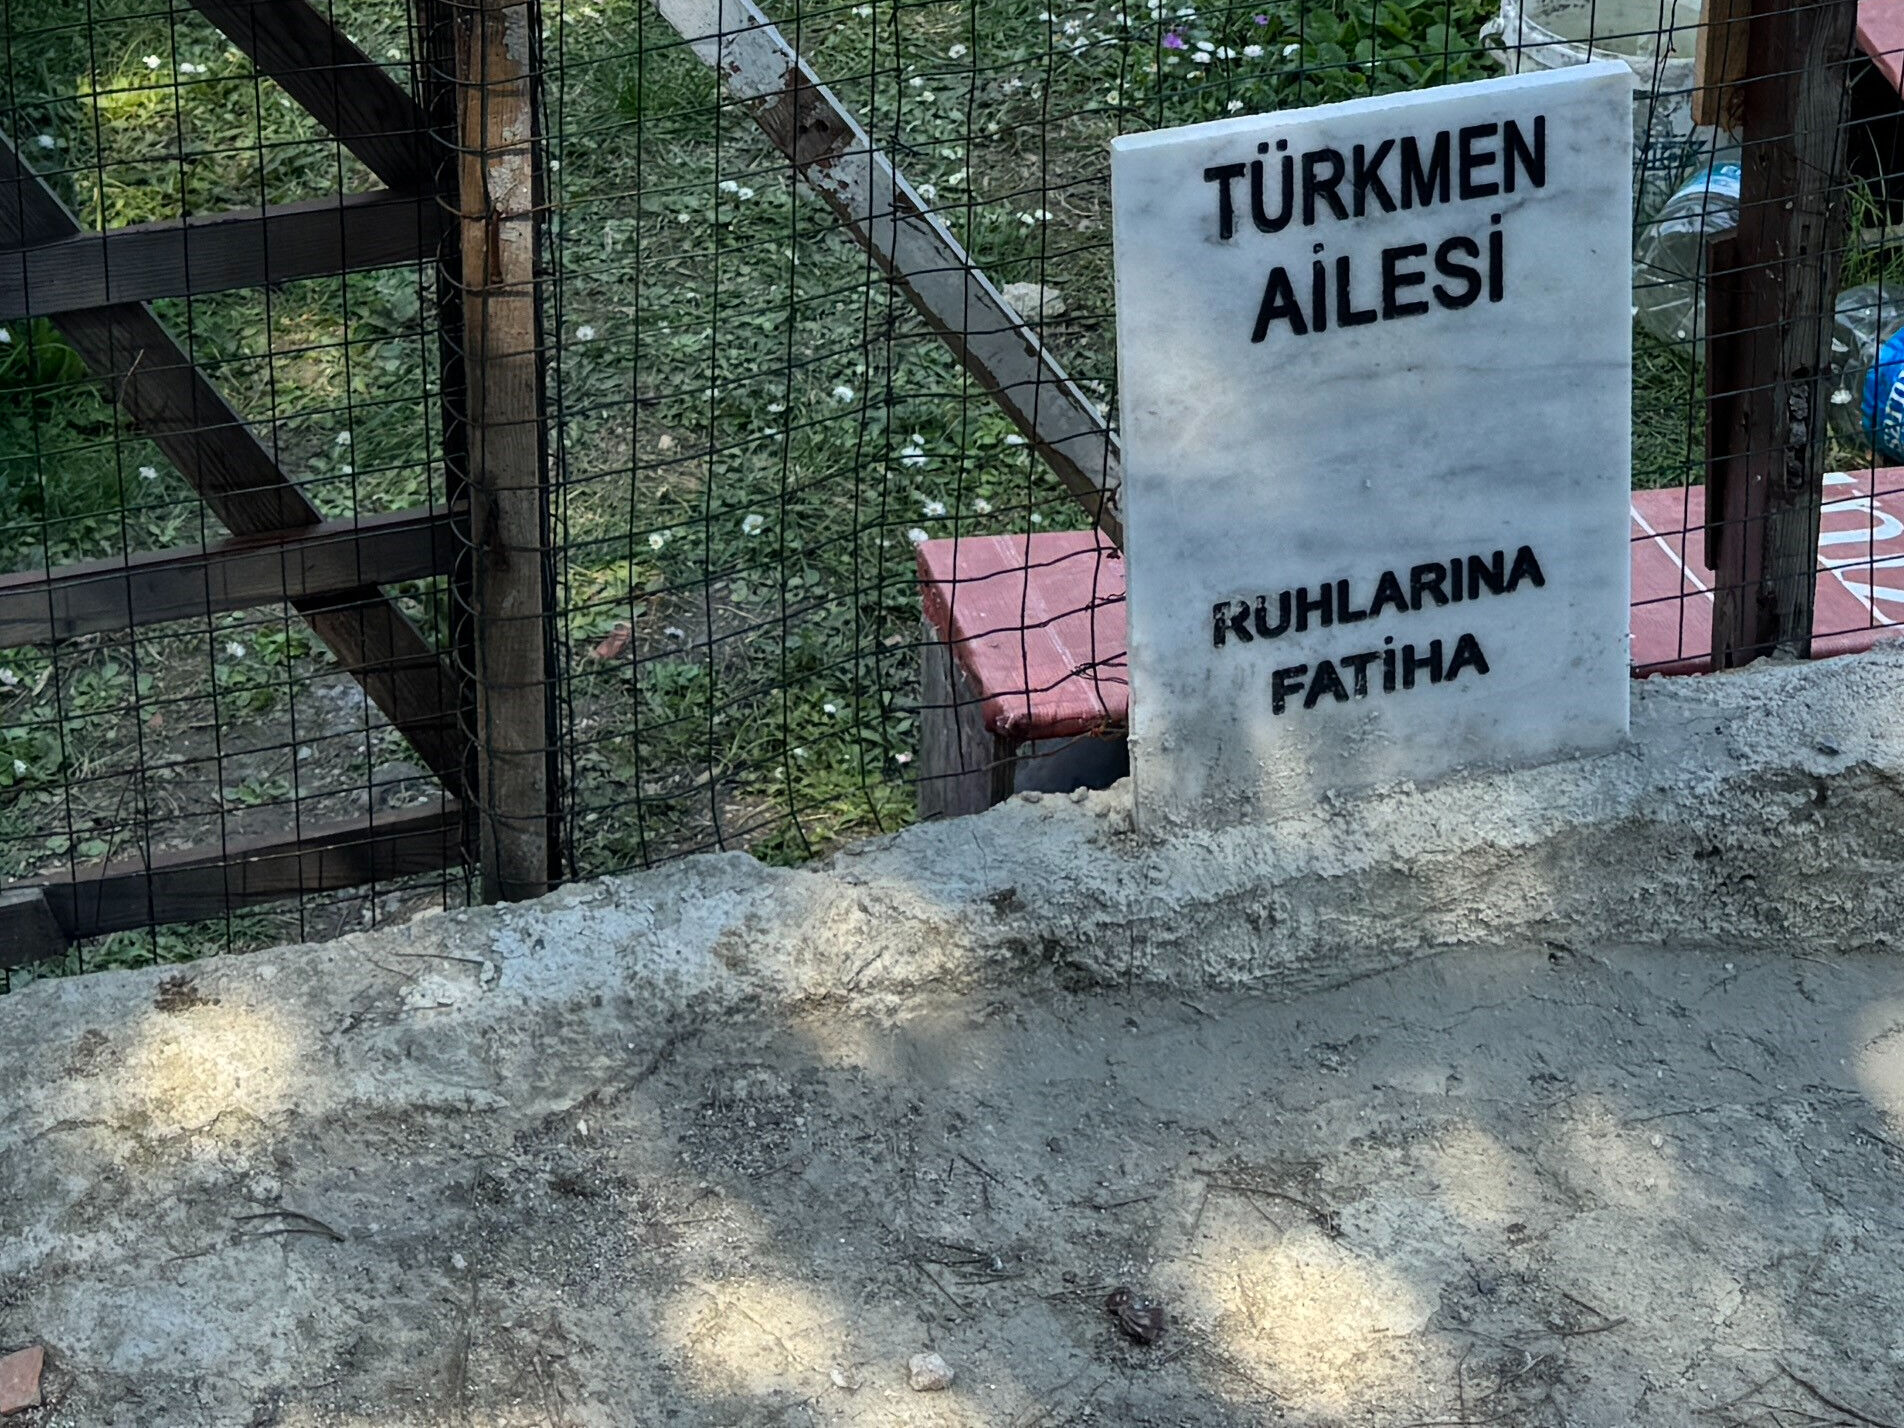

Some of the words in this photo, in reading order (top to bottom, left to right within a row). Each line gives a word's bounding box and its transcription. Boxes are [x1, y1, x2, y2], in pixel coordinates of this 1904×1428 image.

[1204, 115, 1546, 240] TÜRKMEN
[1252, 213, 1504, 343] AİLESİ
[1212, 545, 1544, 648] RUHLARINA
[1270, 634, 1489, 715] FATİHA
